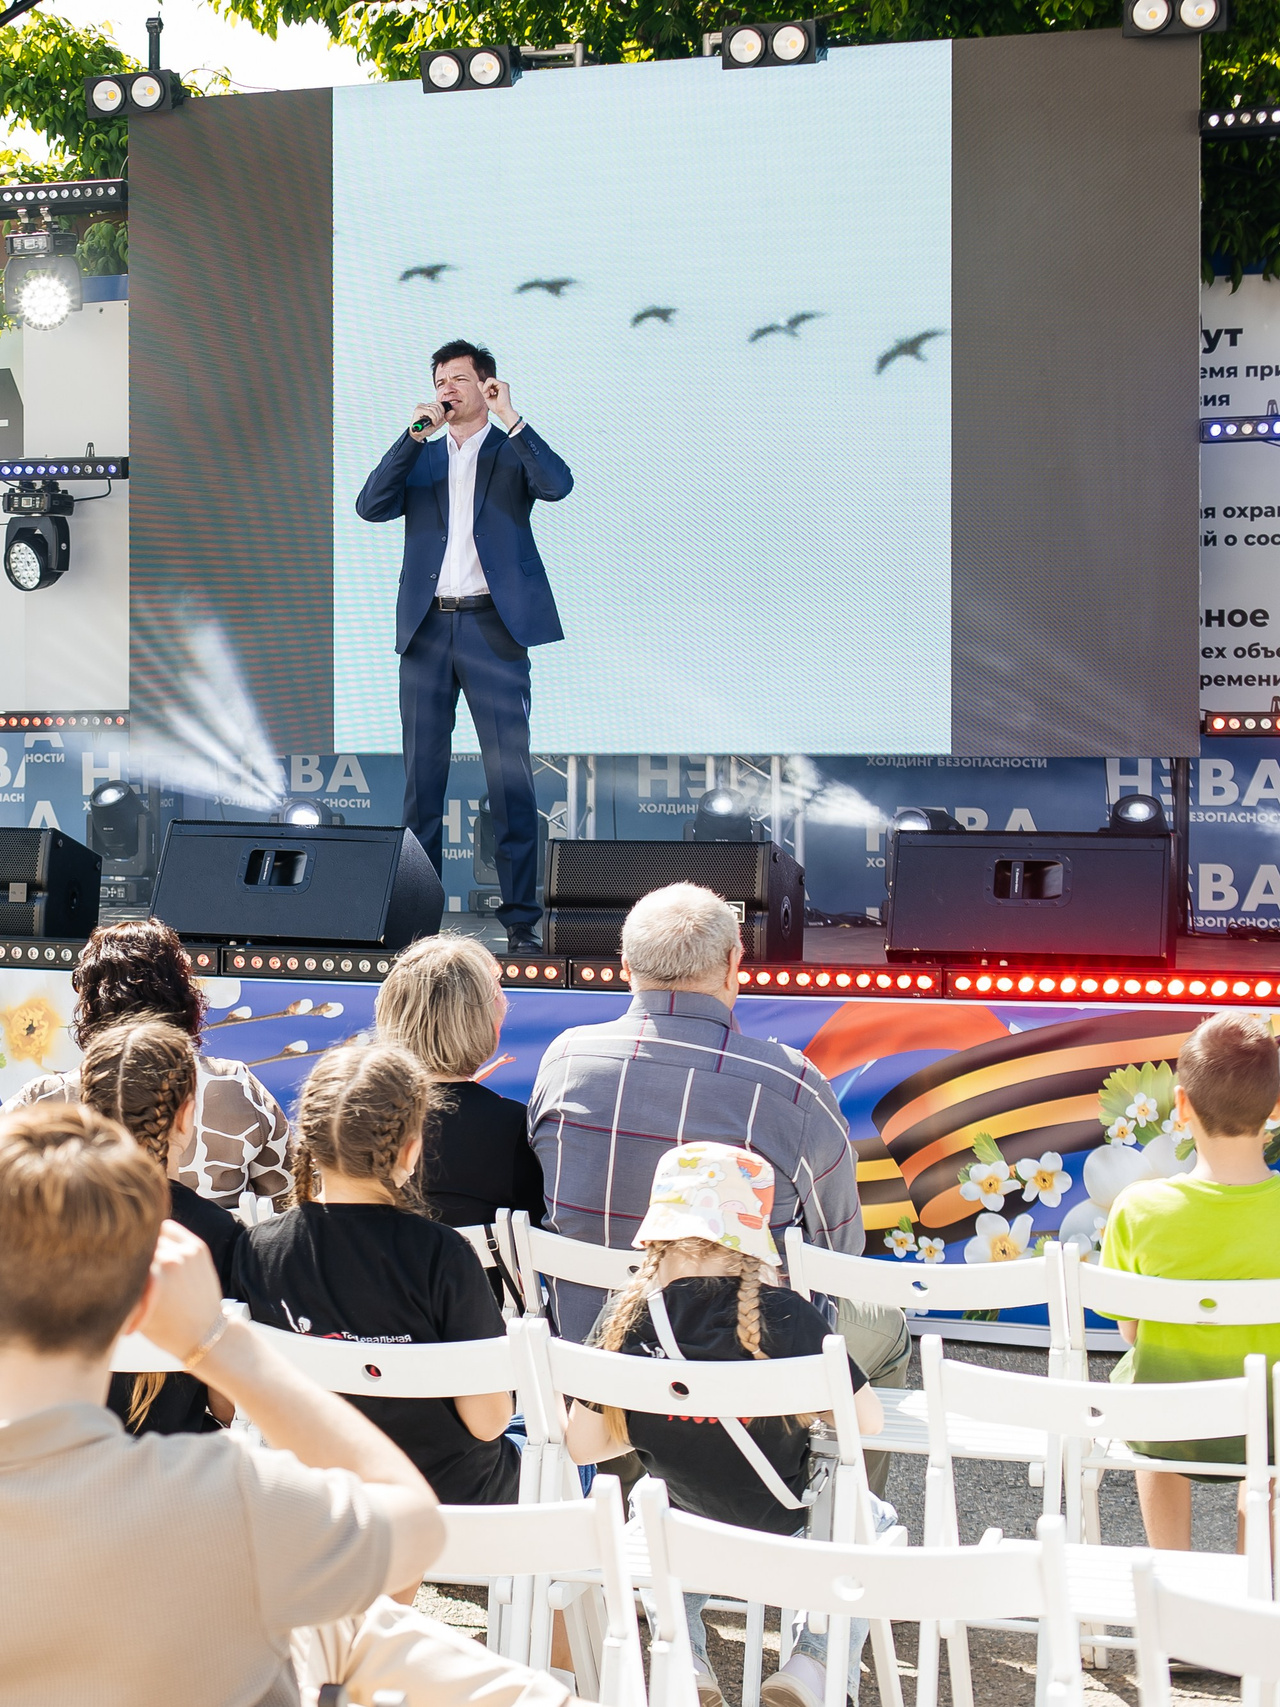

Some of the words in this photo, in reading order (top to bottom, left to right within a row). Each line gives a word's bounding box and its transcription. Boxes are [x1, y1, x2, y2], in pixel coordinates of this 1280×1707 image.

[1200, 394, 1230, 407] ия
[1223, 505, 1280, 522] охра
[1224, 534, 1237, 546] о
[1200, 608, 1269, 628] ное
[867, 757, 933, 768] ХОЛДИНГ
[937, 757, 1048, 768] БЕЗОПАСНОСТИ
[1189, 812, 1280, 823] ЕЗОПАСНОС
